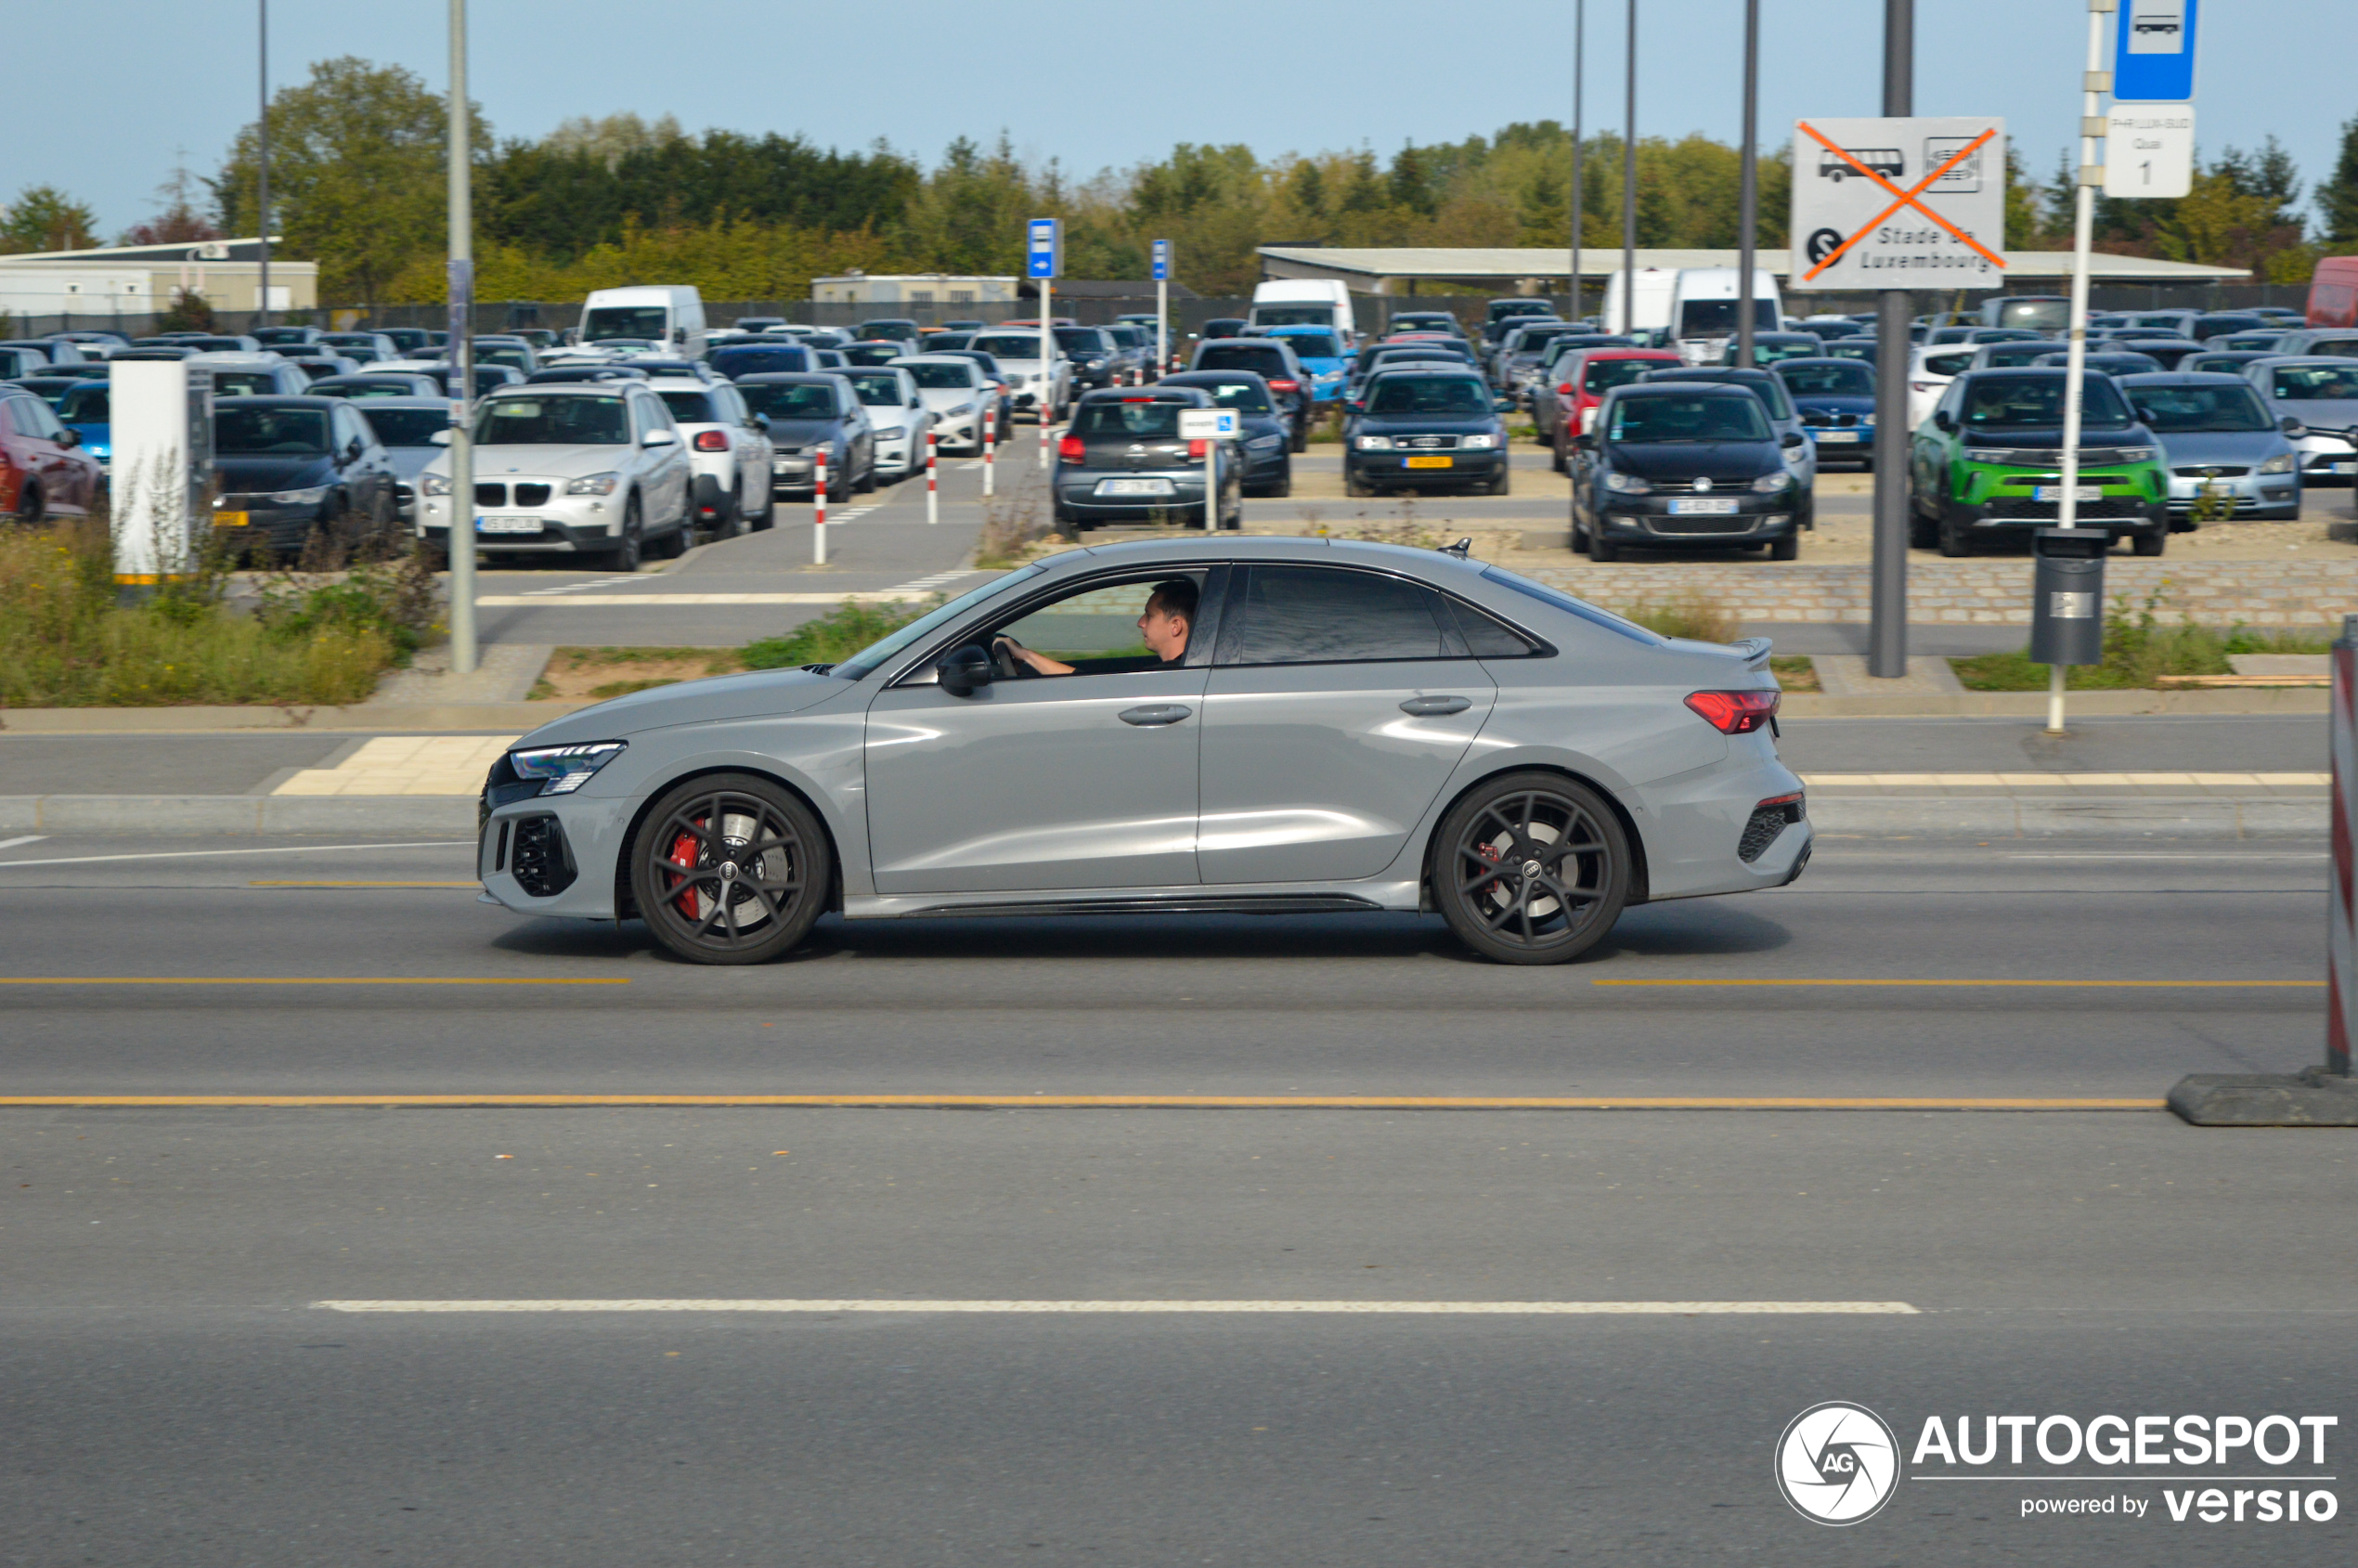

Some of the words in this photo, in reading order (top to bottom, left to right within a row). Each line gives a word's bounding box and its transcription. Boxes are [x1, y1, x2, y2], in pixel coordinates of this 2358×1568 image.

[2138, 160, 2151, 186] 1
[1877, 227, 1941, 244] Stade
[1859, 251, 1990, 273] Luxembourg
